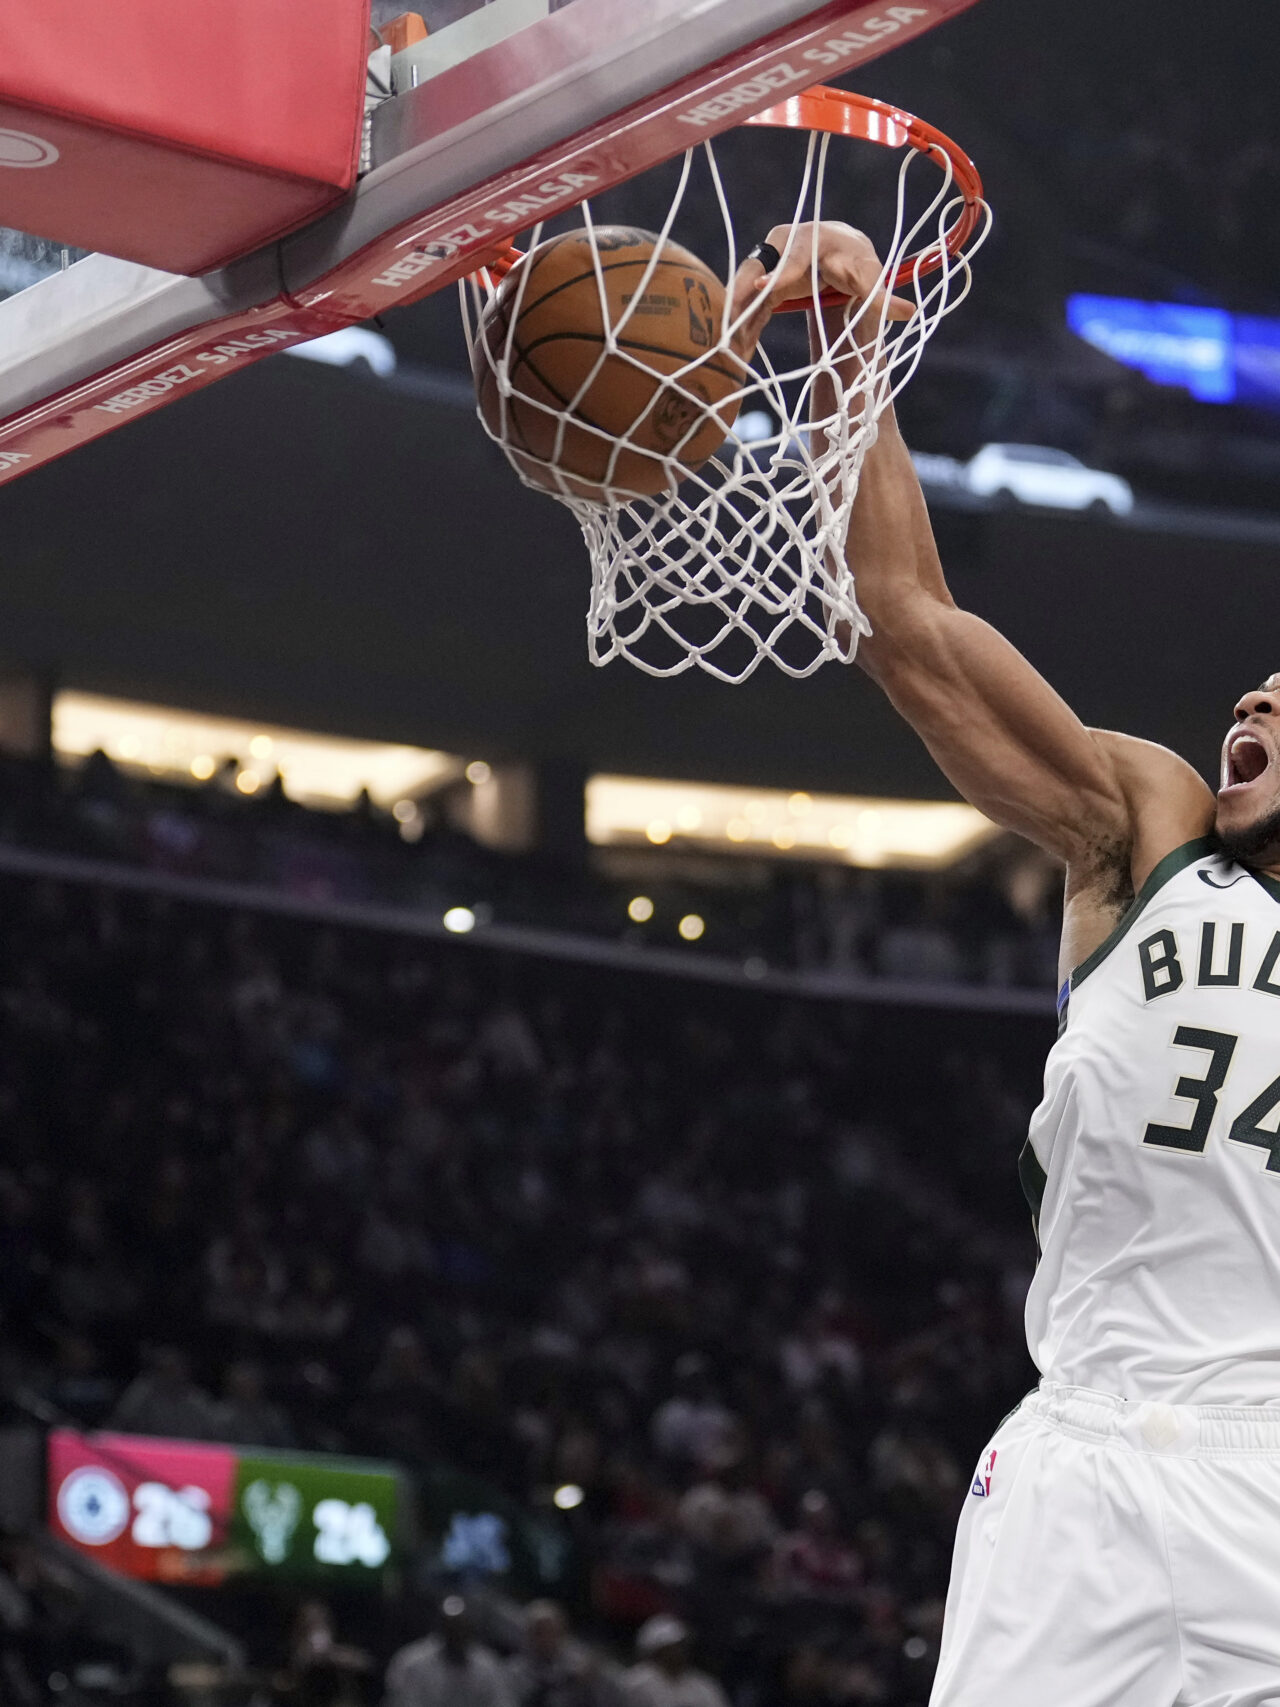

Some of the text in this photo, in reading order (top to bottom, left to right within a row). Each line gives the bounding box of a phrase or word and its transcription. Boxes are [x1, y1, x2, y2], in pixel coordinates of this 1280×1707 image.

[677, 6, 928, 127] HERDEZ SALSA
[371, 172, 599, 287] HERDEZ SALSA
[93, 329, 300, 414] HERDEZ SALSA
[311, 1498, 391, 1568] 24
